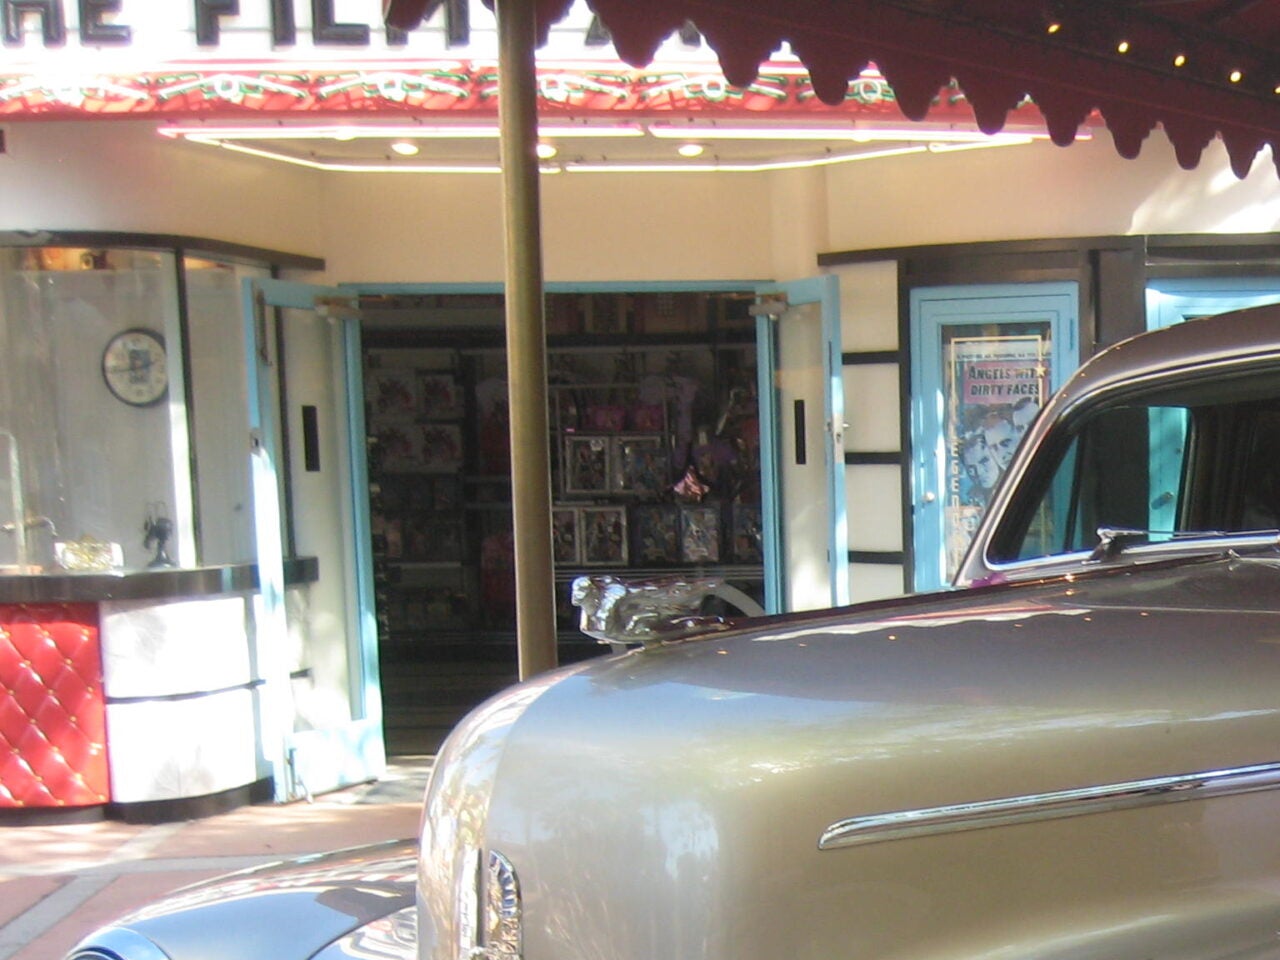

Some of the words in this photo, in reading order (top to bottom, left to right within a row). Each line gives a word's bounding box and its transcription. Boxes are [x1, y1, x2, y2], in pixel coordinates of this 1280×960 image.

[968, 365, 1011, 380] ANGELS
[1014, 367, 1049, 380] WIT
[970, 384, 1003, 396] DIRTY
[1007, 383, 1040, 395] FACES
